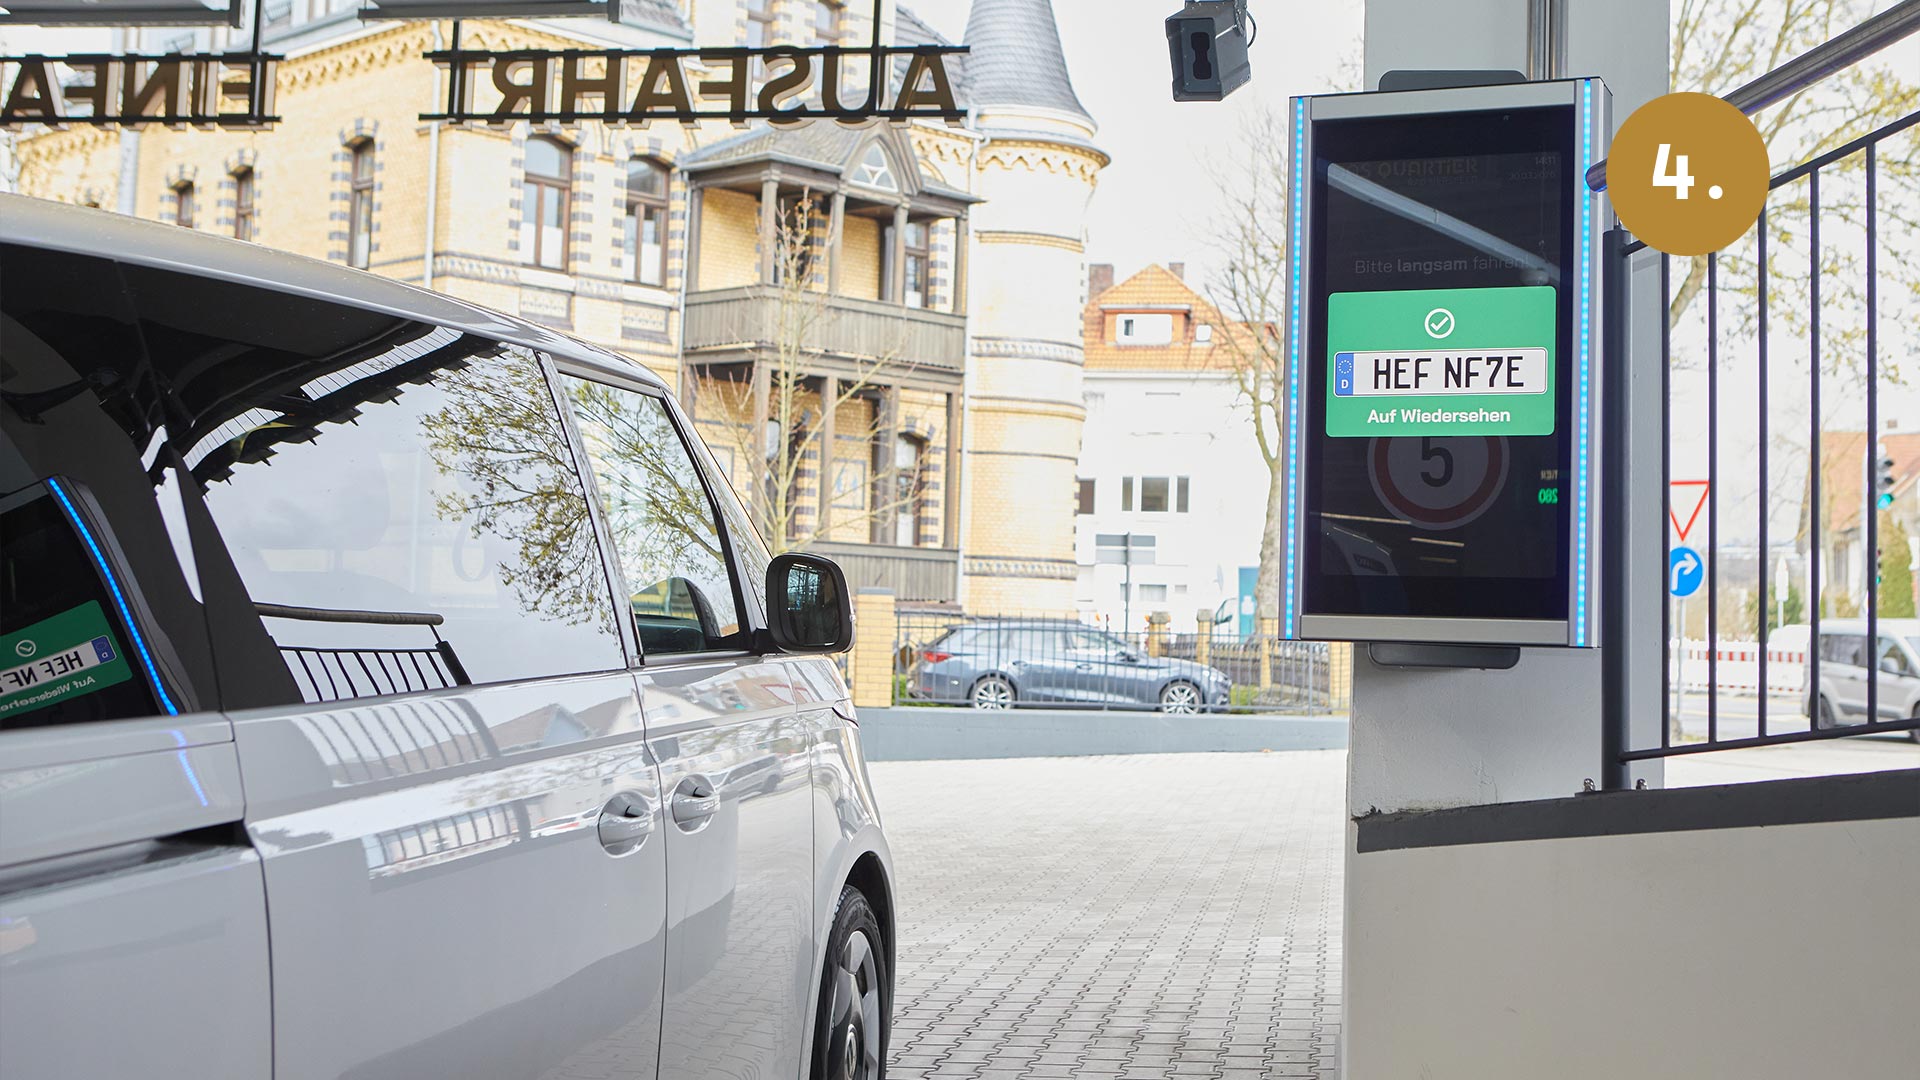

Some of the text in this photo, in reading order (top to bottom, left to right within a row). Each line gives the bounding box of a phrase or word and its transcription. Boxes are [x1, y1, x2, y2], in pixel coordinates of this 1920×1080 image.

[1355, 260, 1393, 274] Bitte
[1397, 258, 1468, 275] langsam
[1373, 355, 1524, 390] HEF NF7E
[1341, 379, 1349, 389] D
[1367, 408, 1511, 424] Auf Wiedersehen
[1420, 436, 1454, 488] 5
